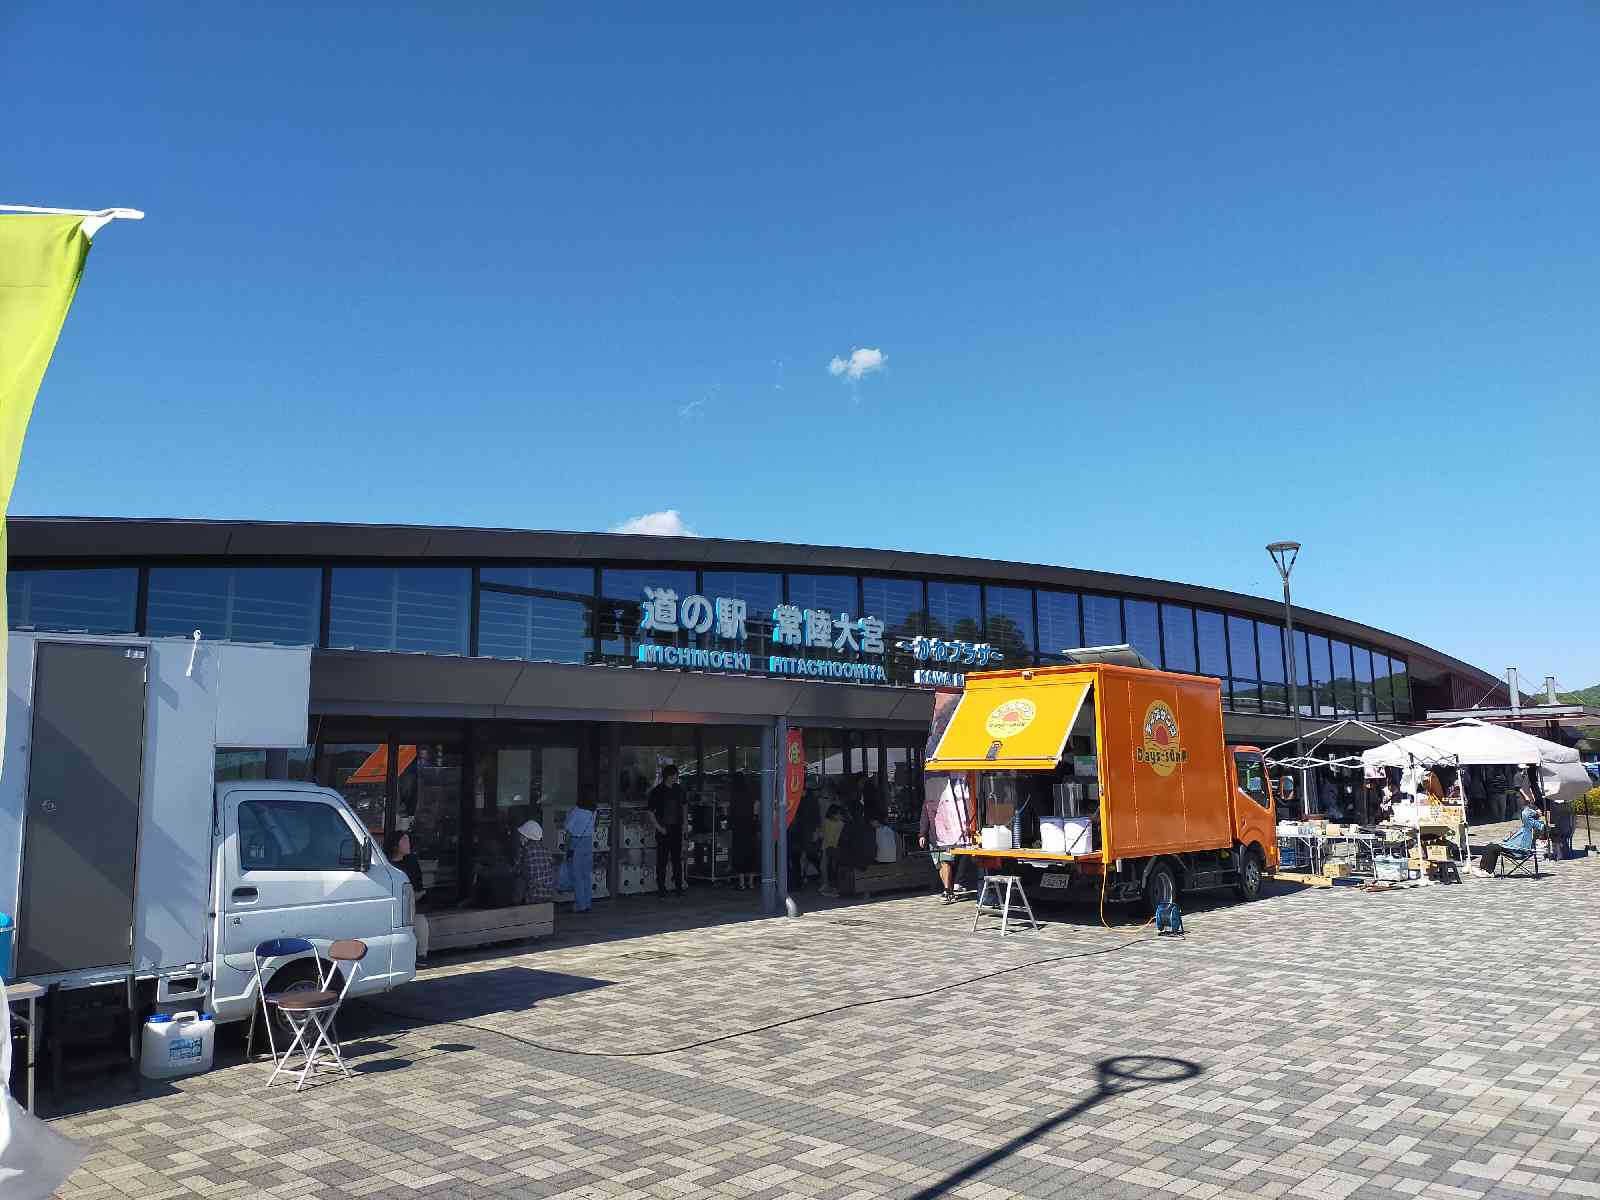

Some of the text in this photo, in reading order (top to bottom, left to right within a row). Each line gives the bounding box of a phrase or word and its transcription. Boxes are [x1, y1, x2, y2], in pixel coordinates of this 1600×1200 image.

[641, 586, 885, 655] 道の駅 常陸大宮
[638, 644, 888, 681] MICHINOEKI HITACHIOOMIYA
